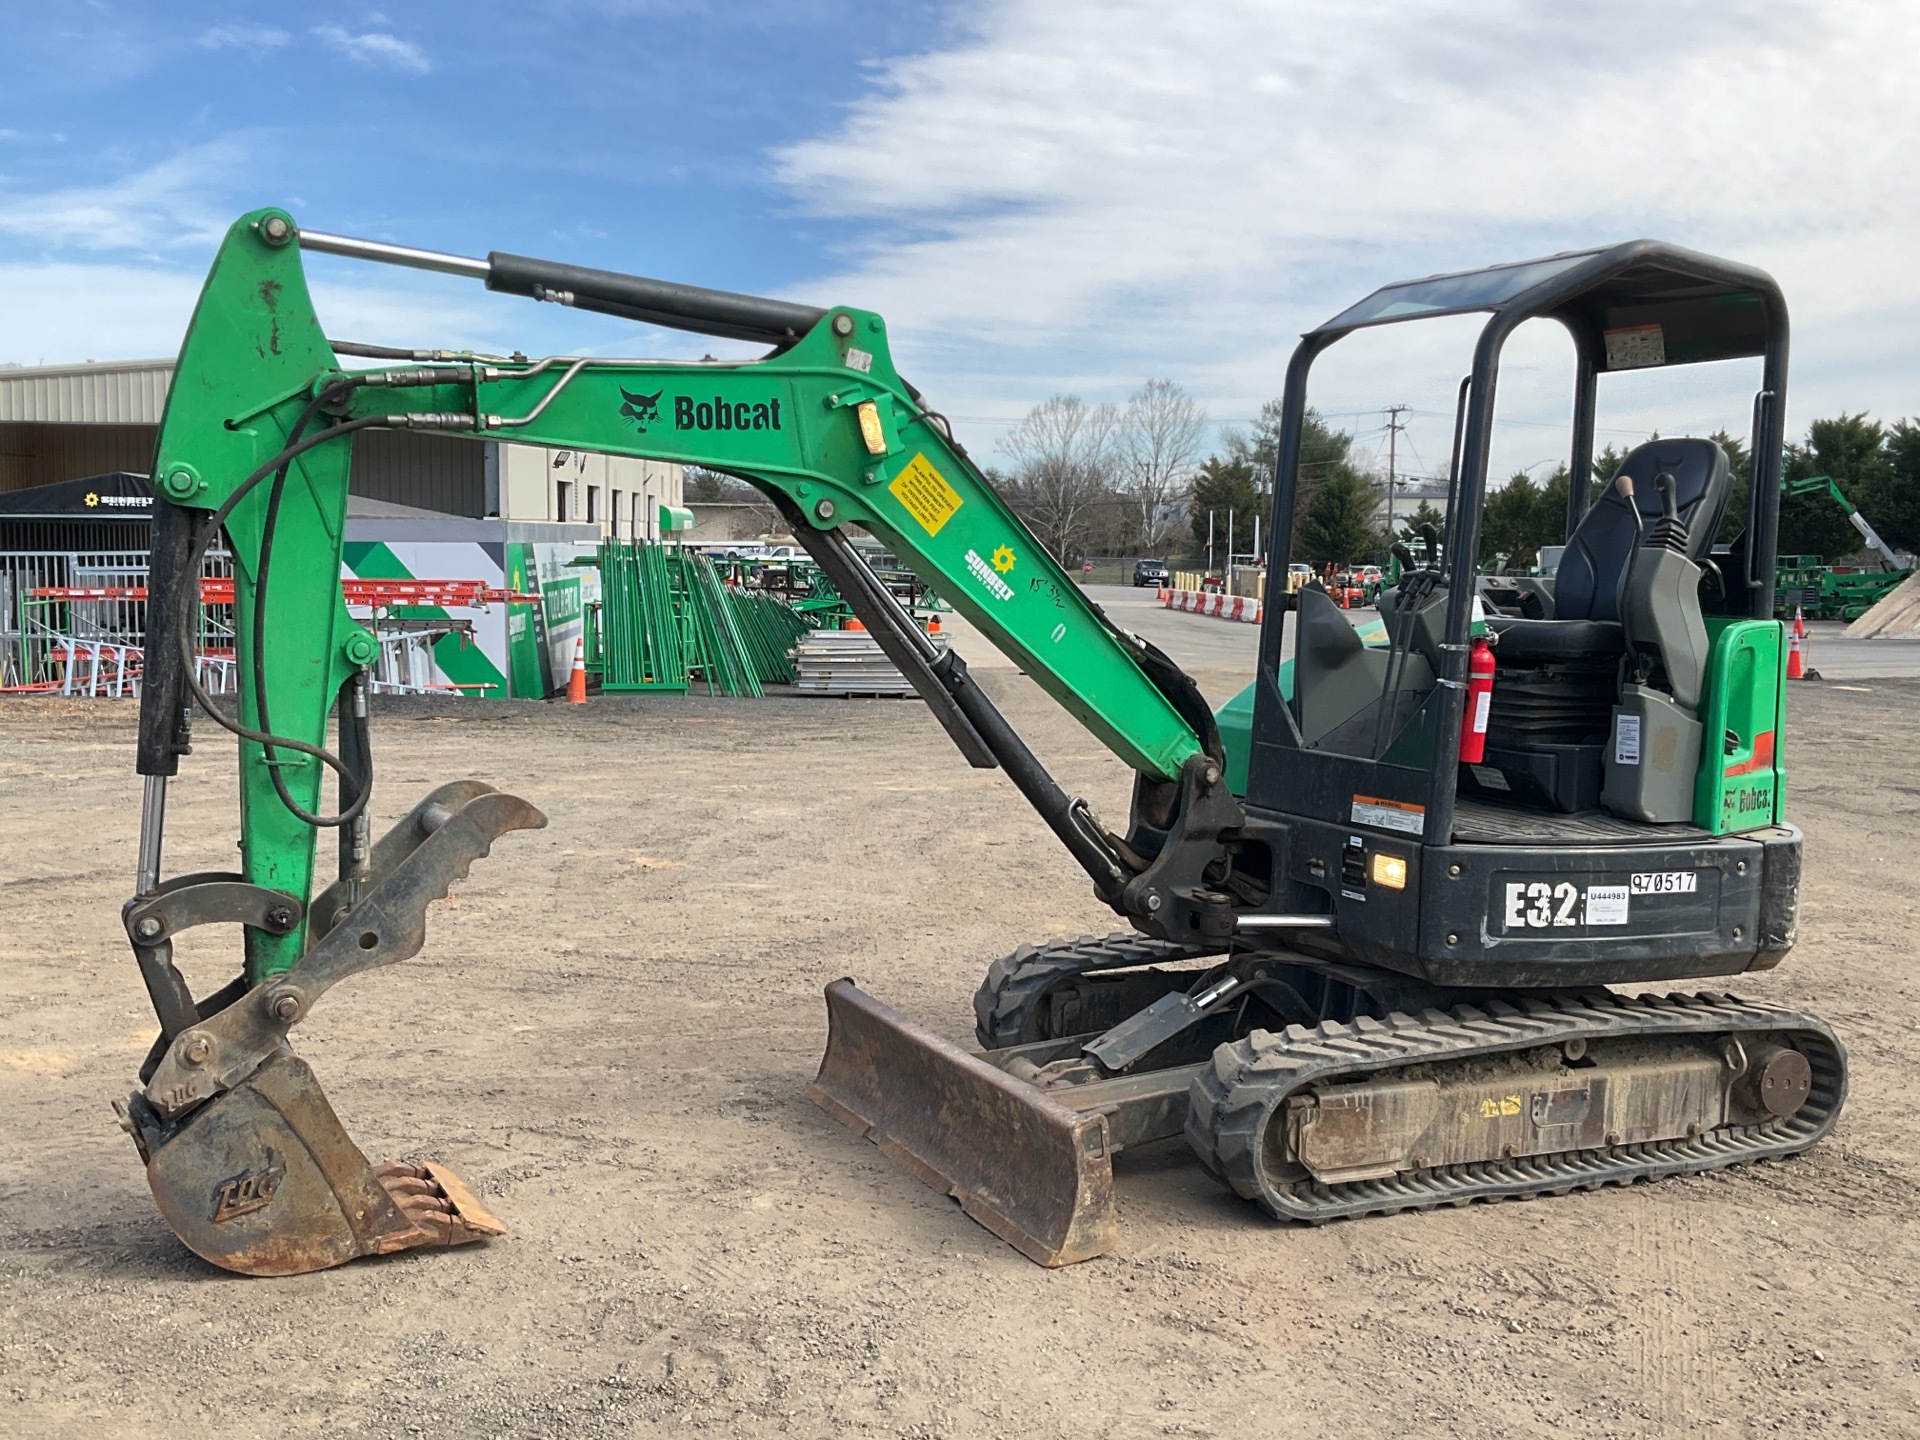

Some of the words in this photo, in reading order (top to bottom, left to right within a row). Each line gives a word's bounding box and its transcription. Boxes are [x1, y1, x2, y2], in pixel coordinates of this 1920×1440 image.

[674, 396, 781, 430] Bobcat
[909, 481, 922, 495] WITHIN
[921, 494, 930, 504] TEN
[929, 504, 940, 514] FEET
[911, 464, 932, 486] UNLAWFUL
[936, 492, 954, 511] OPERATE
[913, 475, 923, 486] THIS
[922, 485, 944, 509] EQUIPMENT
[928, 473, 947, 492] WARNING
[901, 492, 919, 510] VOLTAGE
[918, 510, 930, 523] LINES
[907, 489, 929, 512] OVERHEAD
[928, 512, 938, 523] HIGH
[964, 549, 1015, 601] SUNBELT
[966, 564, 1001, 601] RENTALS
[1632, 873, 1695, 892] 970517
